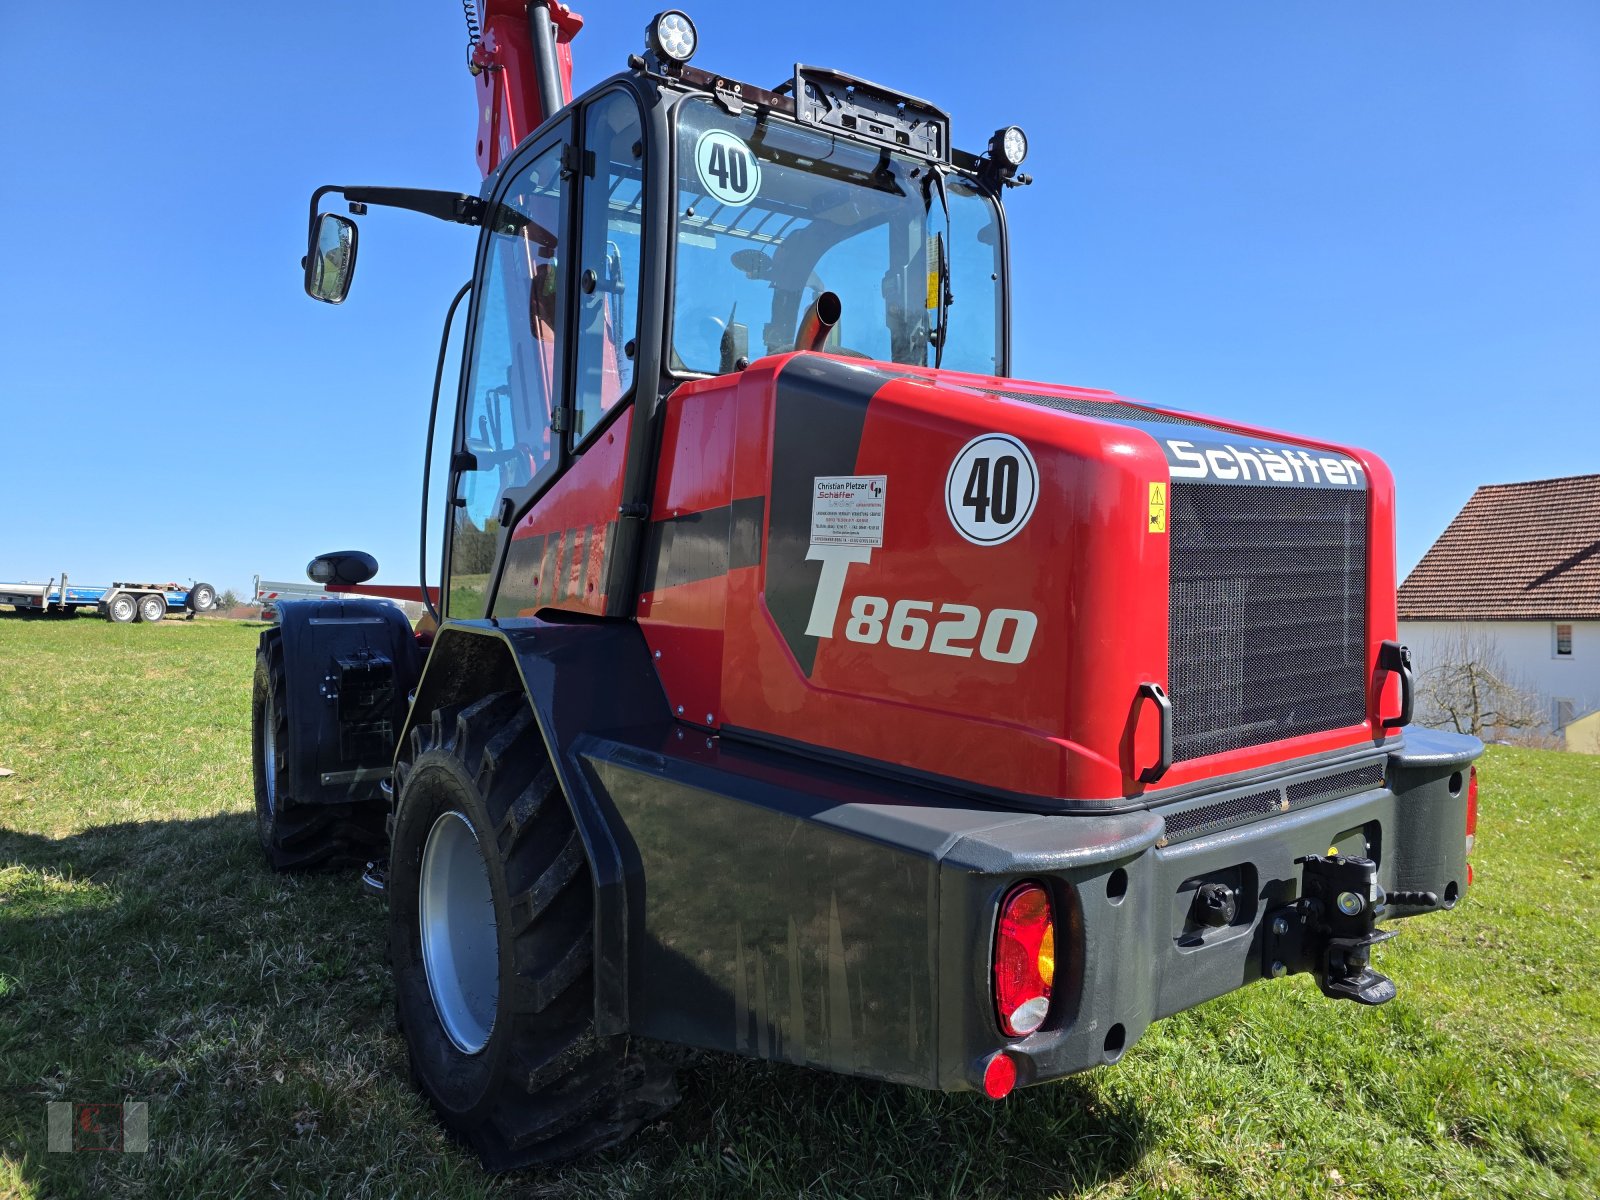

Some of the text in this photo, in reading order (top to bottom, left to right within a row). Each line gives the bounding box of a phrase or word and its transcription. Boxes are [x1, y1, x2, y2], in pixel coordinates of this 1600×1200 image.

[708, 142, 748, 194] 40
[1167, 439, 1365, 485] Schäffer
[817, 481, 868, 490] Christian Pletzer
[817, 491, 855, 499] Schäffer
[962, 455, 1020, 525] 40
